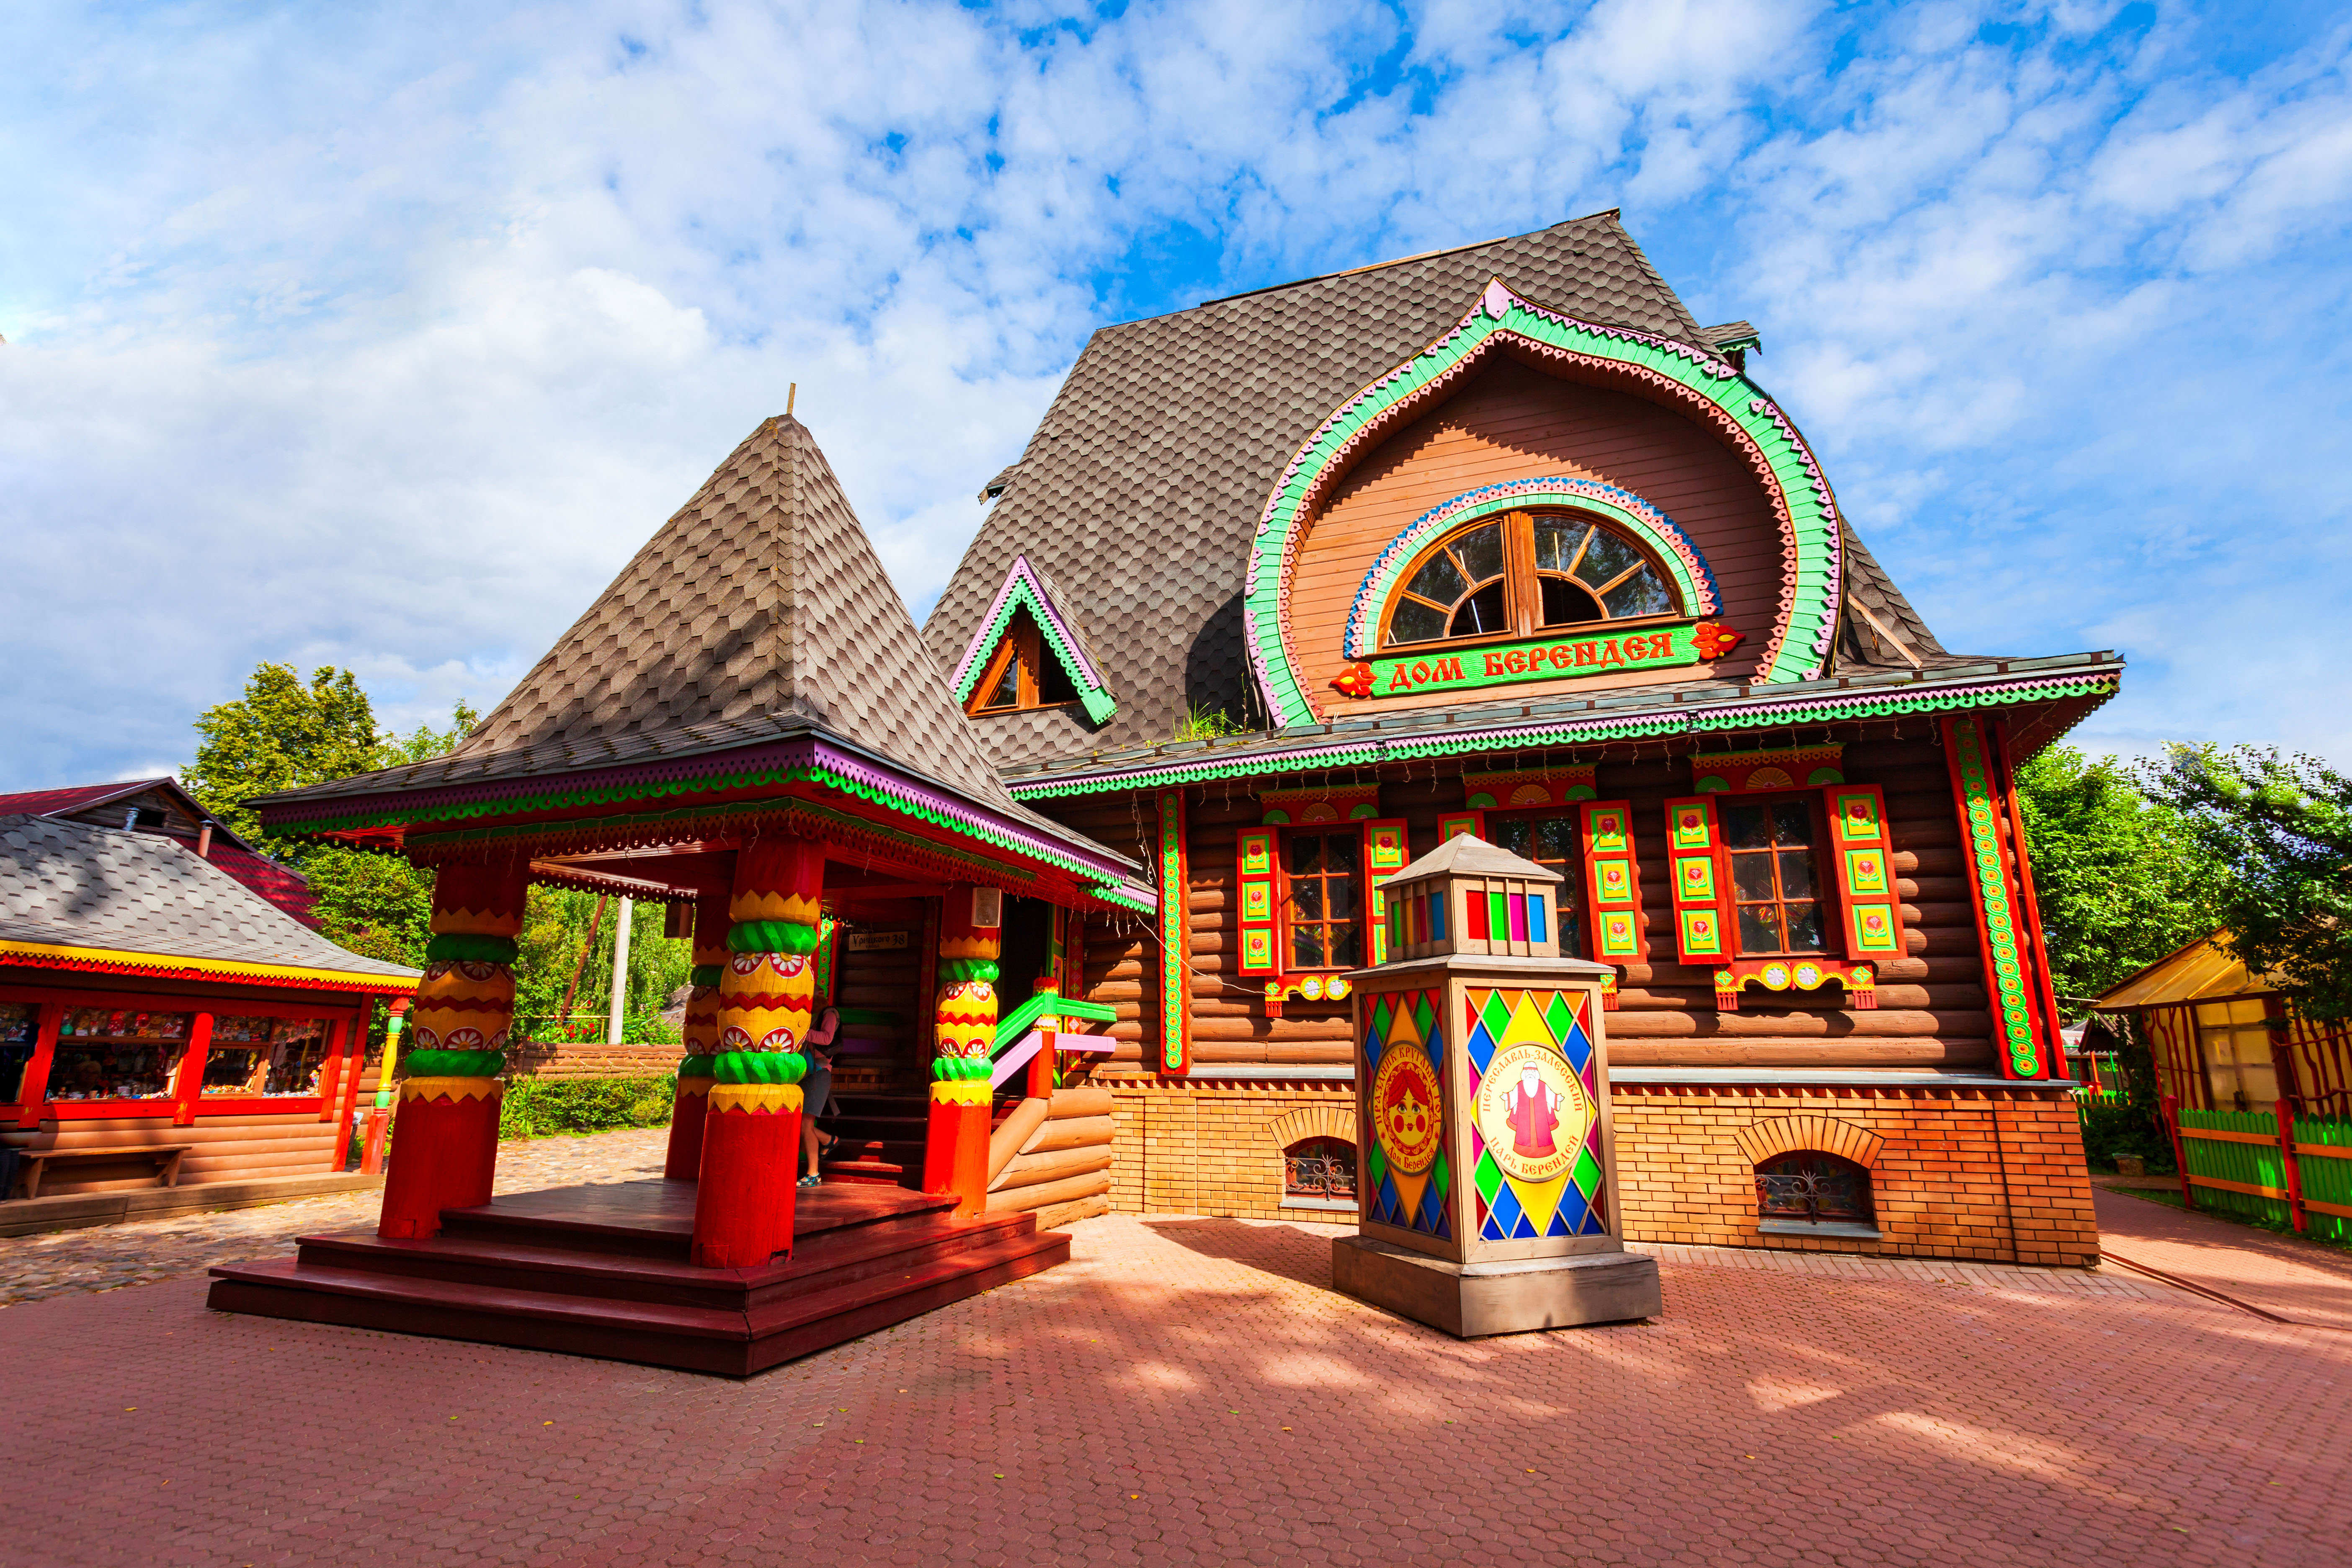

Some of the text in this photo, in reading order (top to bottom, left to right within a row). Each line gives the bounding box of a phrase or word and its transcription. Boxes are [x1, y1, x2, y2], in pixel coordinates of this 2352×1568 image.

[1390, 632, 1675, 691] ДОМ БЕРЕНДЕЯ
[892, 934, 905, 946] 38
[1374, 1051, 1397, 1125] ПРАЗДНИК
[1483, 1049, 1585, 1112] ПЕРЕСЛАВЛЬ-ЗАЛЕССКИЙ
[1387, 1145, 1435, 1172] Дом Берендея
[1489, 1134, 1580, 1175] ЦАРЬ БЕРЕНДЕЙ
